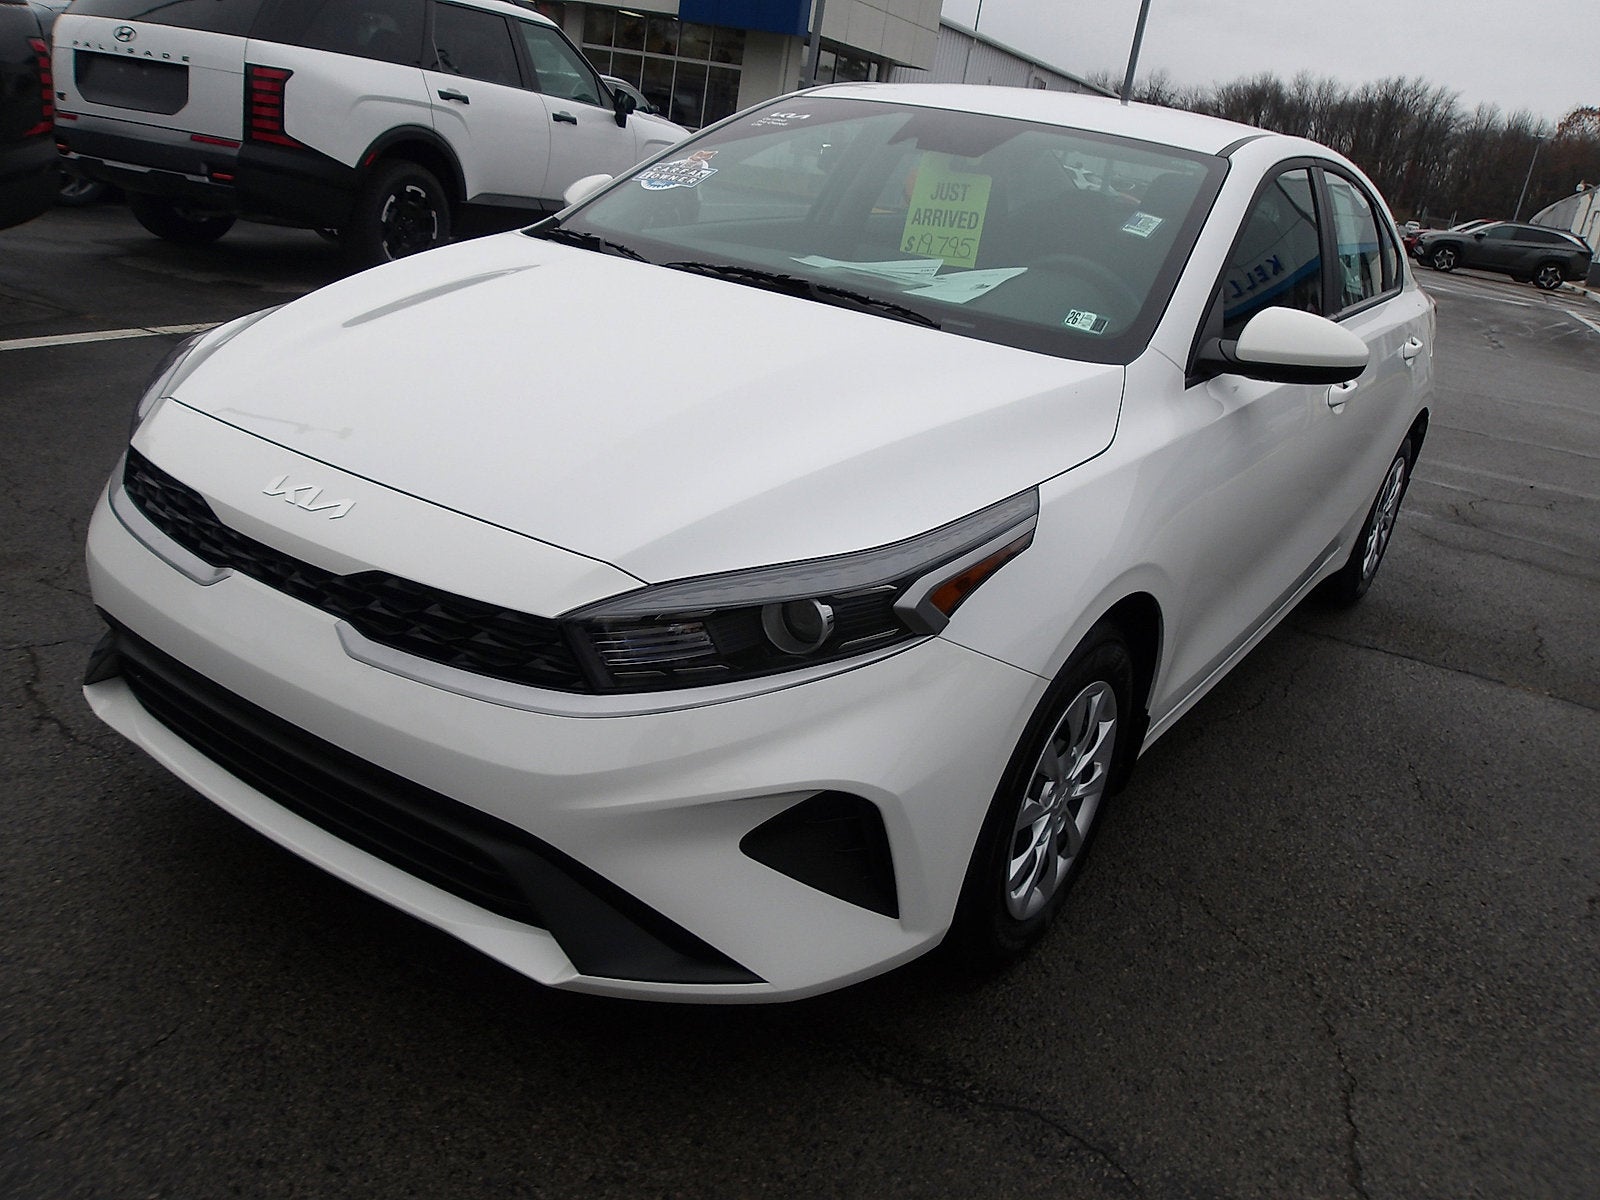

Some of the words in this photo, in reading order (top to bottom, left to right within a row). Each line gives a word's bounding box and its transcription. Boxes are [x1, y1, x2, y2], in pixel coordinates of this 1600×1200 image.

[73, 40, 190, 62] PALISADE
[652, 165, 712, 178] CARFAX
[930, 181, 971, 202] JUST
[911, 207, 979, 230] ARRIVED
[1066, 311, 1082, 325] 26
[262, 474, 357, 520] KIA
